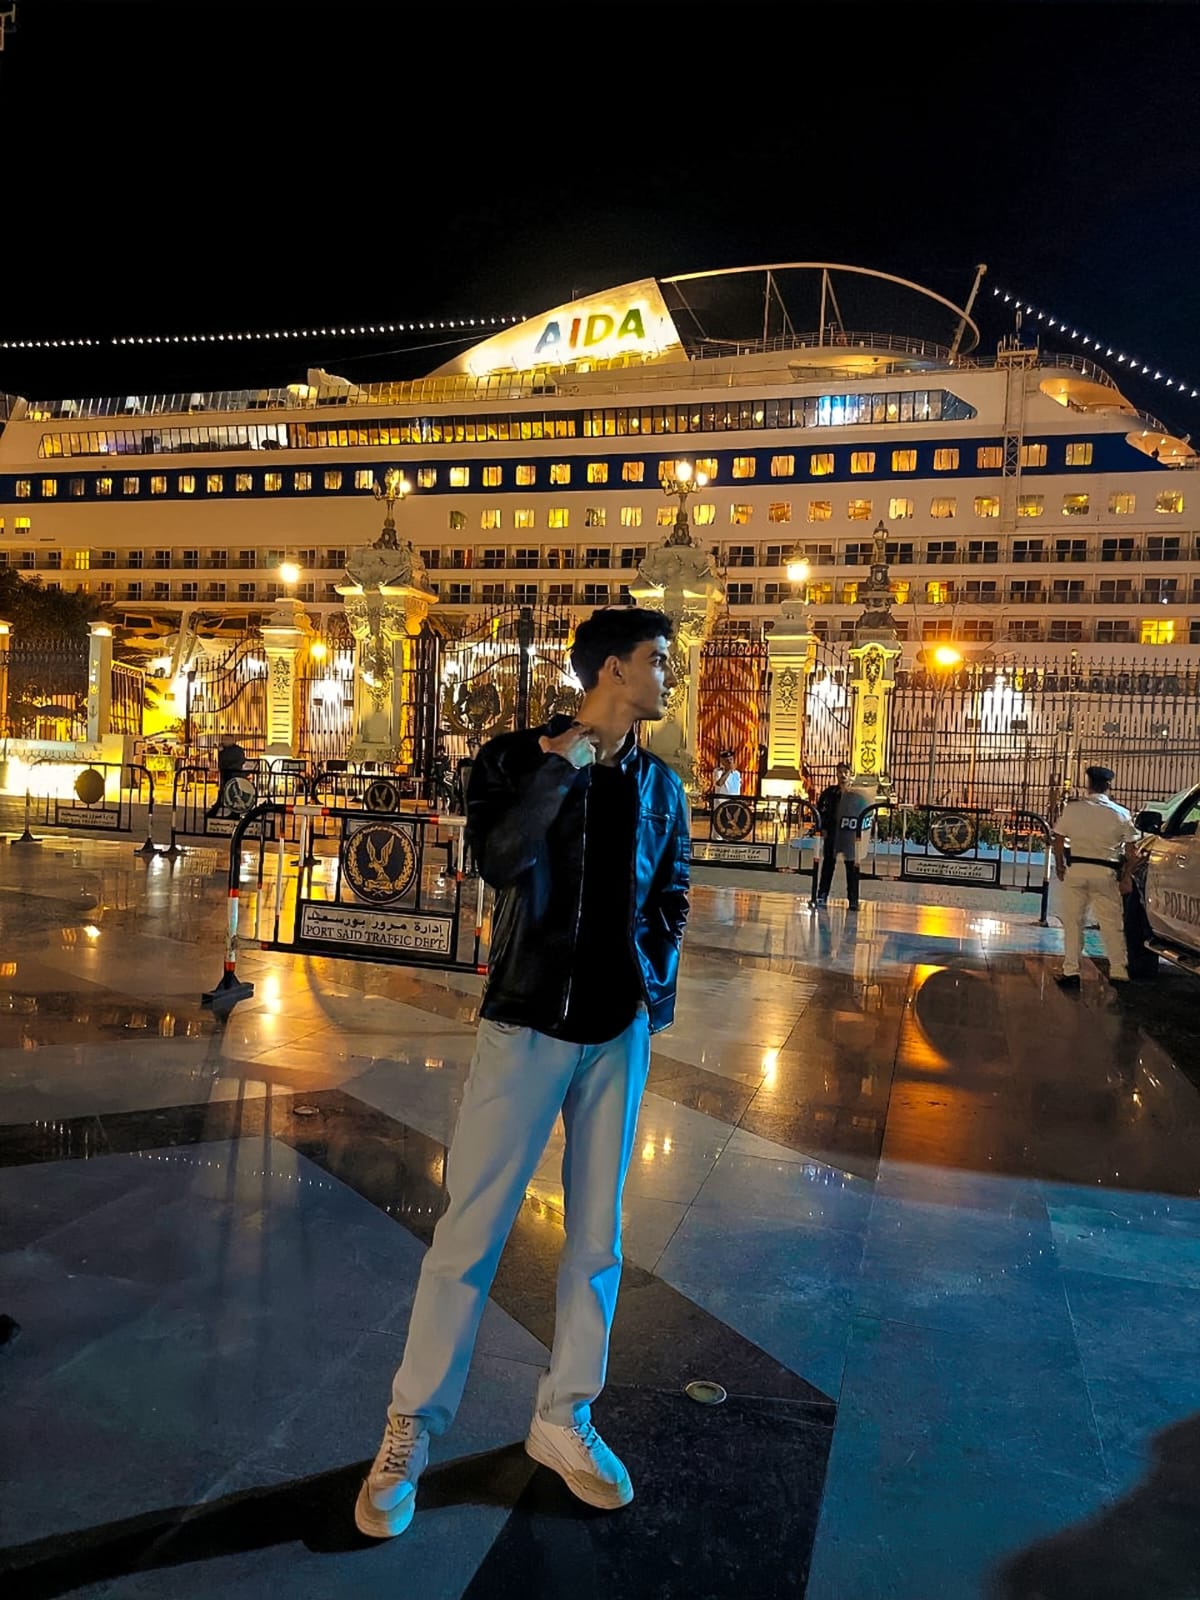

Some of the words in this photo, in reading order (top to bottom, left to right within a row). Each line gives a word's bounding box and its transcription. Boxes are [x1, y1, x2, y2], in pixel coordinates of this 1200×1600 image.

[535, 308, 645, 353] AIDA
[307, 910, 367, 929] بورسعيد
[371, 919, 408, 931] مرور
[414, 921, 444, 937] إدارة
[305, 924, 334, 938] PORT
[336, 928, 362, 941] SAID
[364, 931, 412, 947] TRAFFIC
[414, 935, 447, 949] DEPT.
